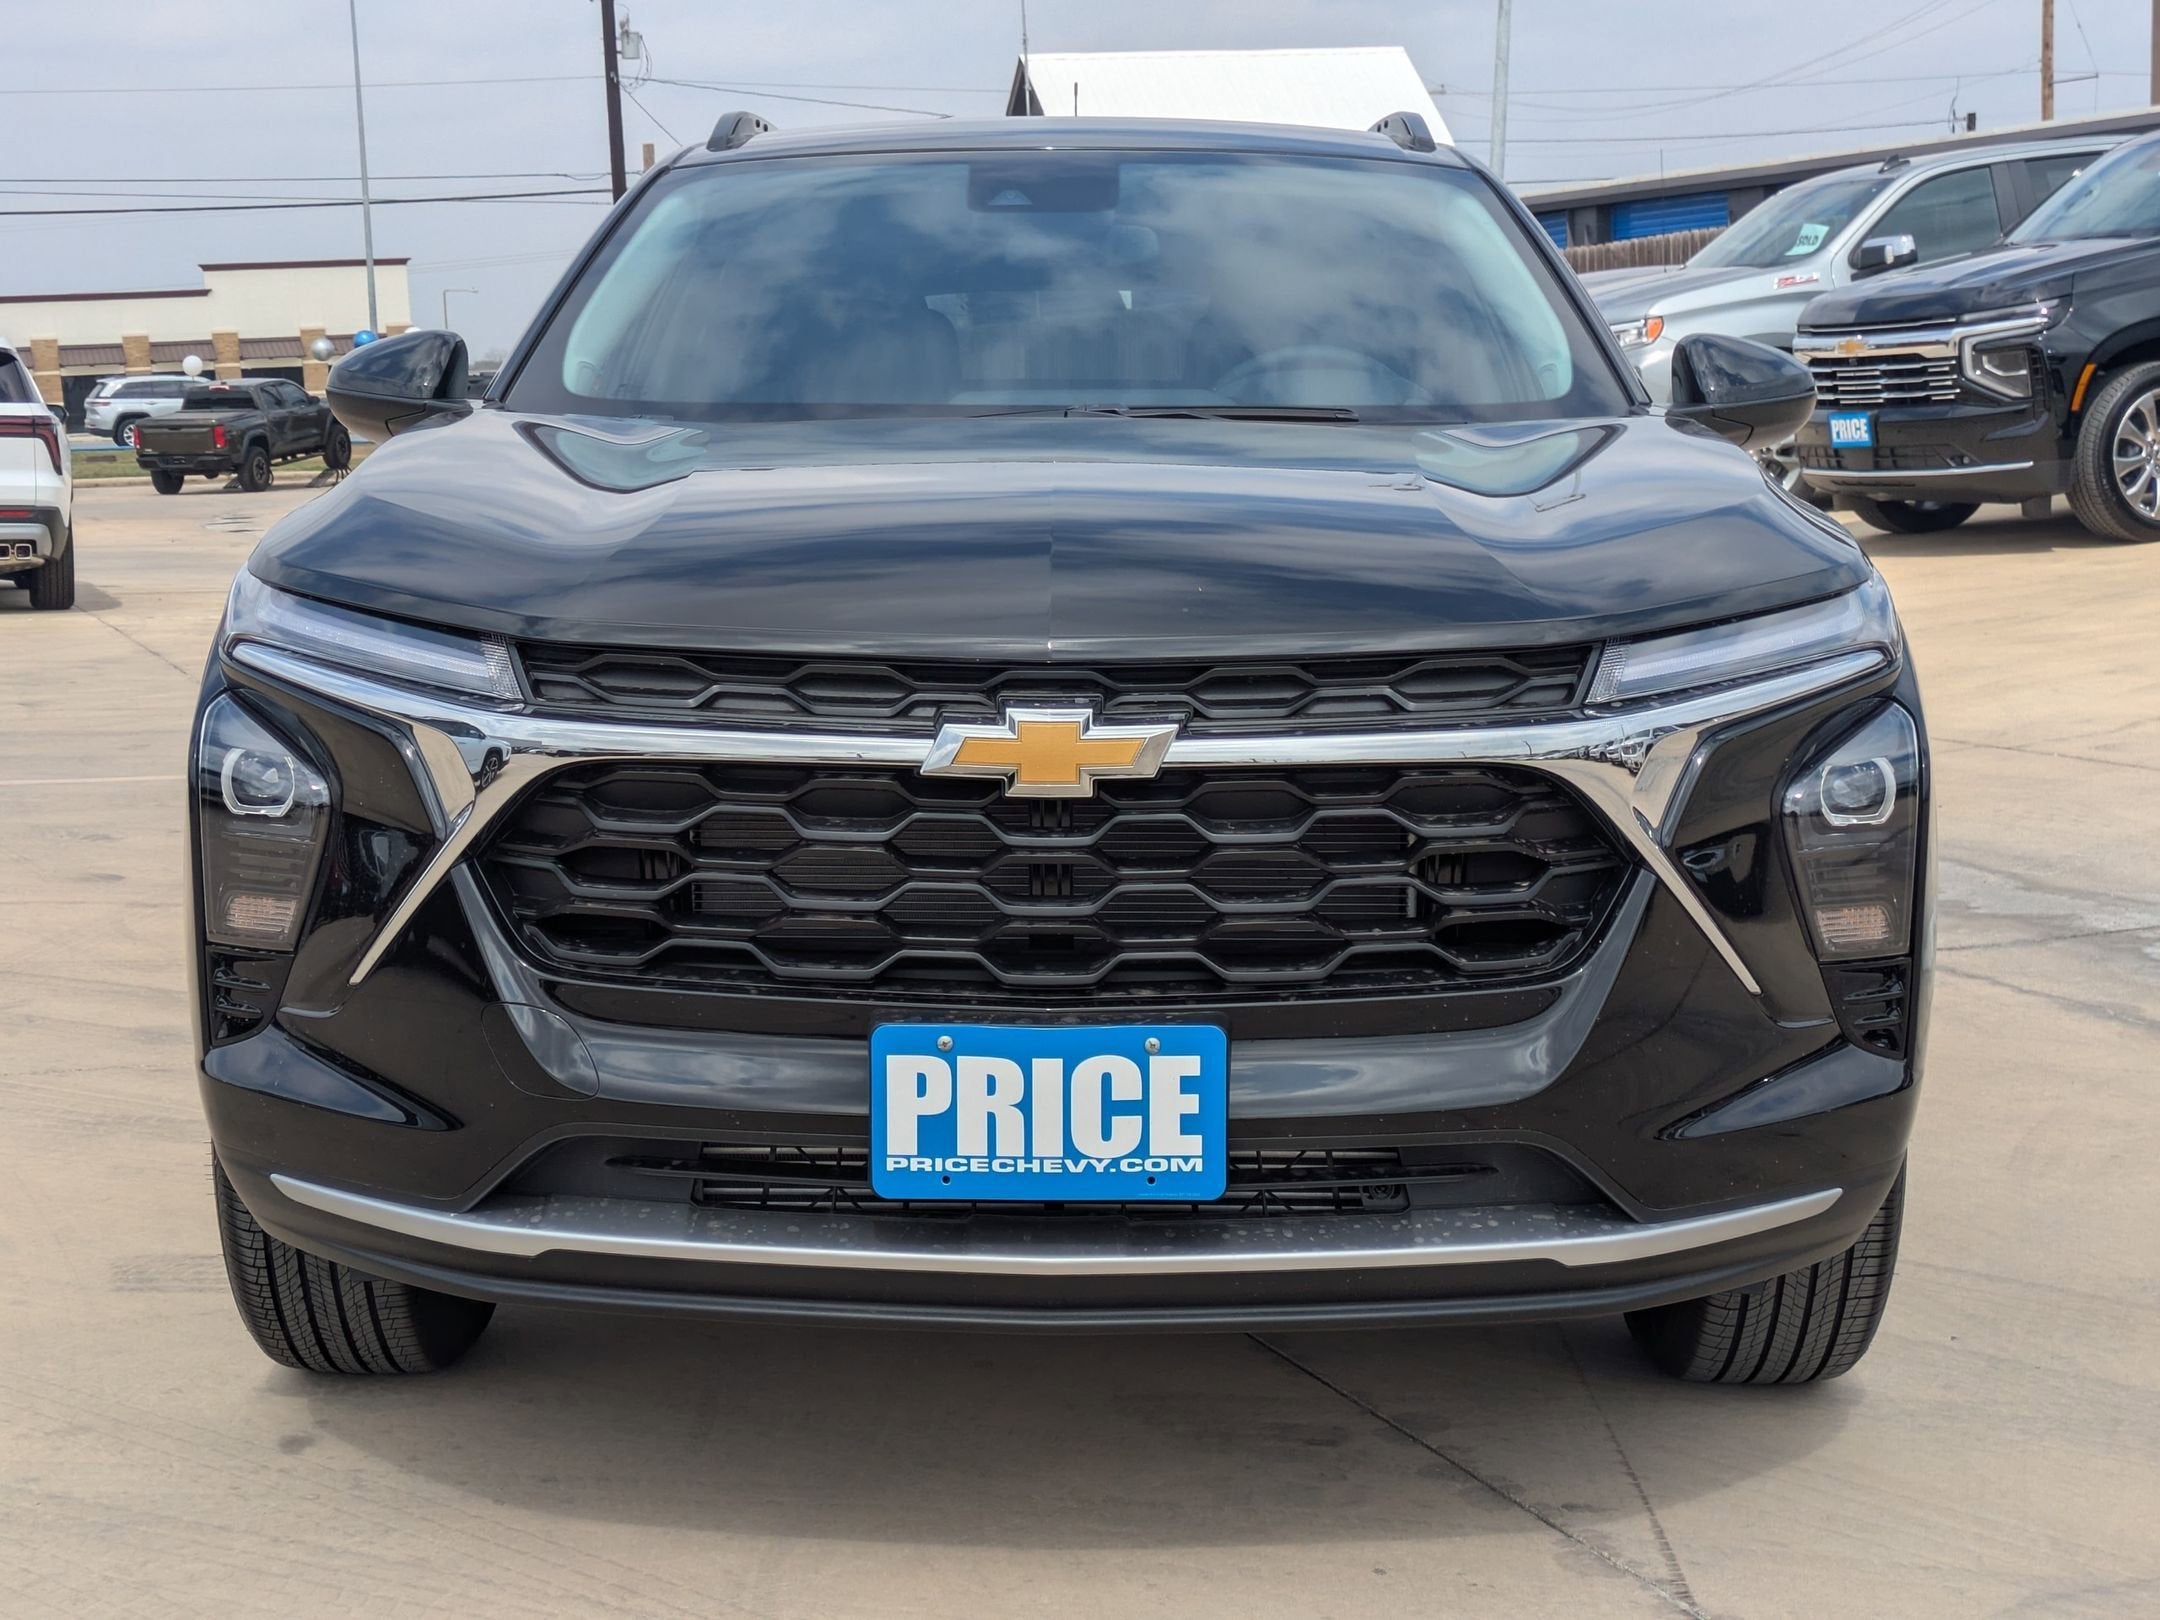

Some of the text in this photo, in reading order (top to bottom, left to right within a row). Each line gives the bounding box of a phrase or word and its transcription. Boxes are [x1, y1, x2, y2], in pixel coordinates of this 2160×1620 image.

[1830, 418, 1868, 441] PRICE
[886, 1054, 1203, 1158] PRICE
[886, 1157, 1203, 1172] PRICECHEVY.COM
